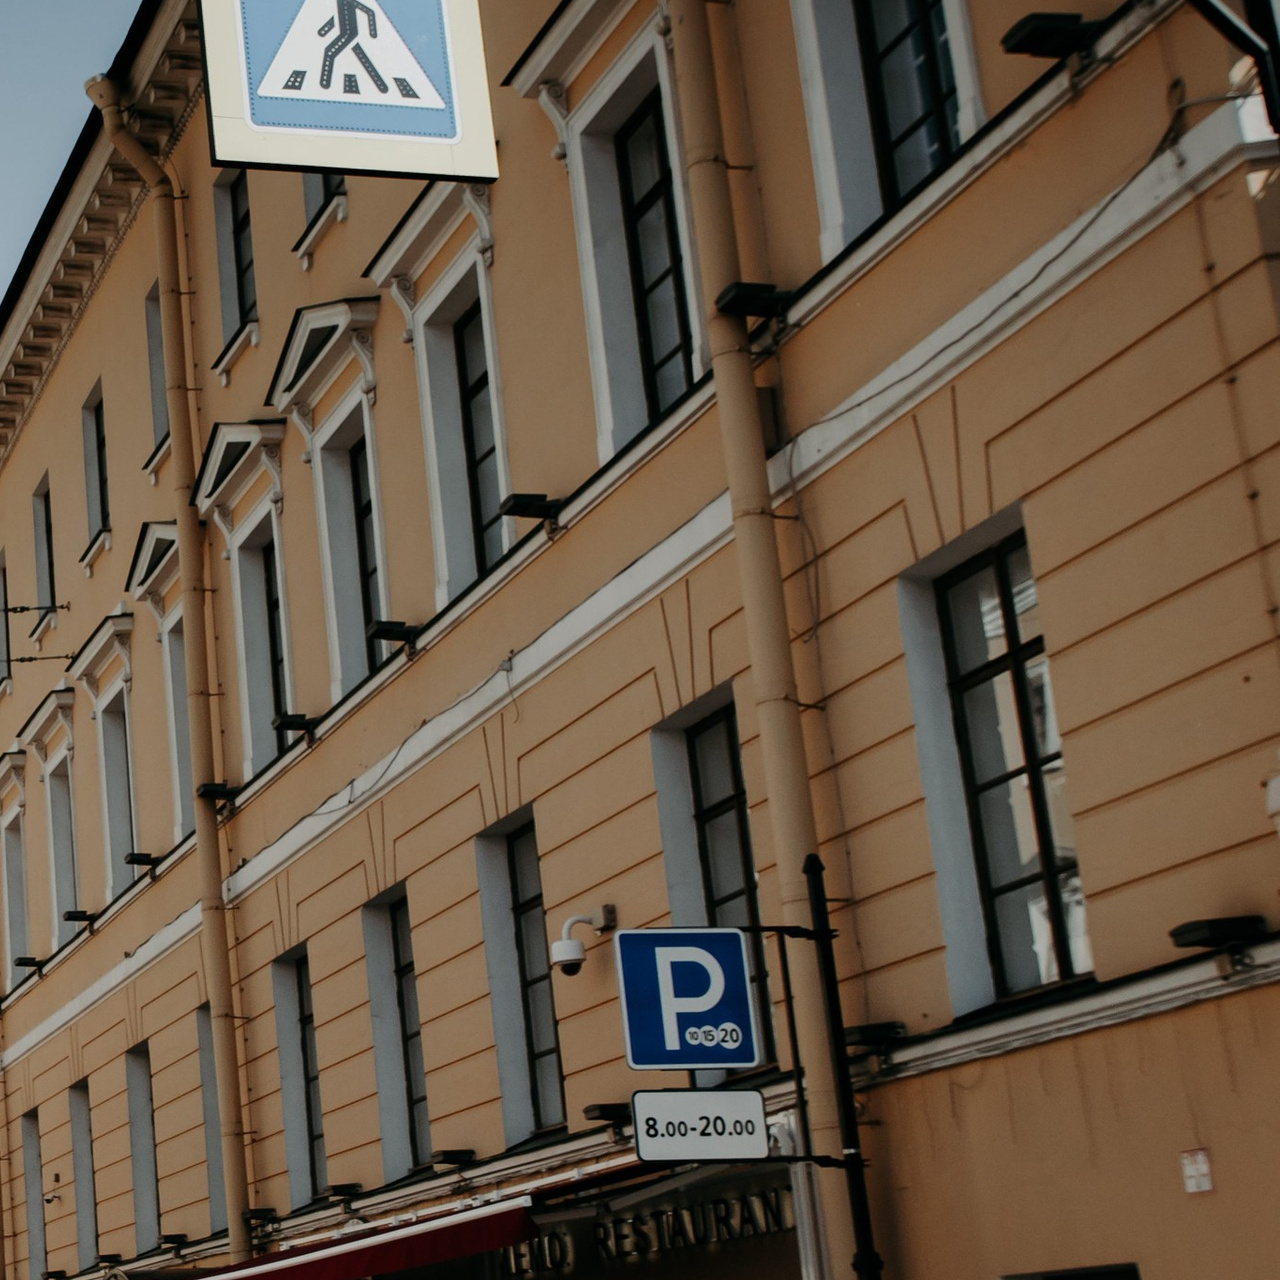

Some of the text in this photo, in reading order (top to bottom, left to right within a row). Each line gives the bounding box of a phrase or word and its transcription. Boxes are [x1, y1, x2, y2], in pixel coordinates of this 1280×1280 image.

[654, 946, 725, 1050] P
[688, 1028, 740, 1043] 10 15 20
[645, 1116, 755, 1138] 8.00-20.00
[593, 1184, 793, 1260] RESTAURAN
